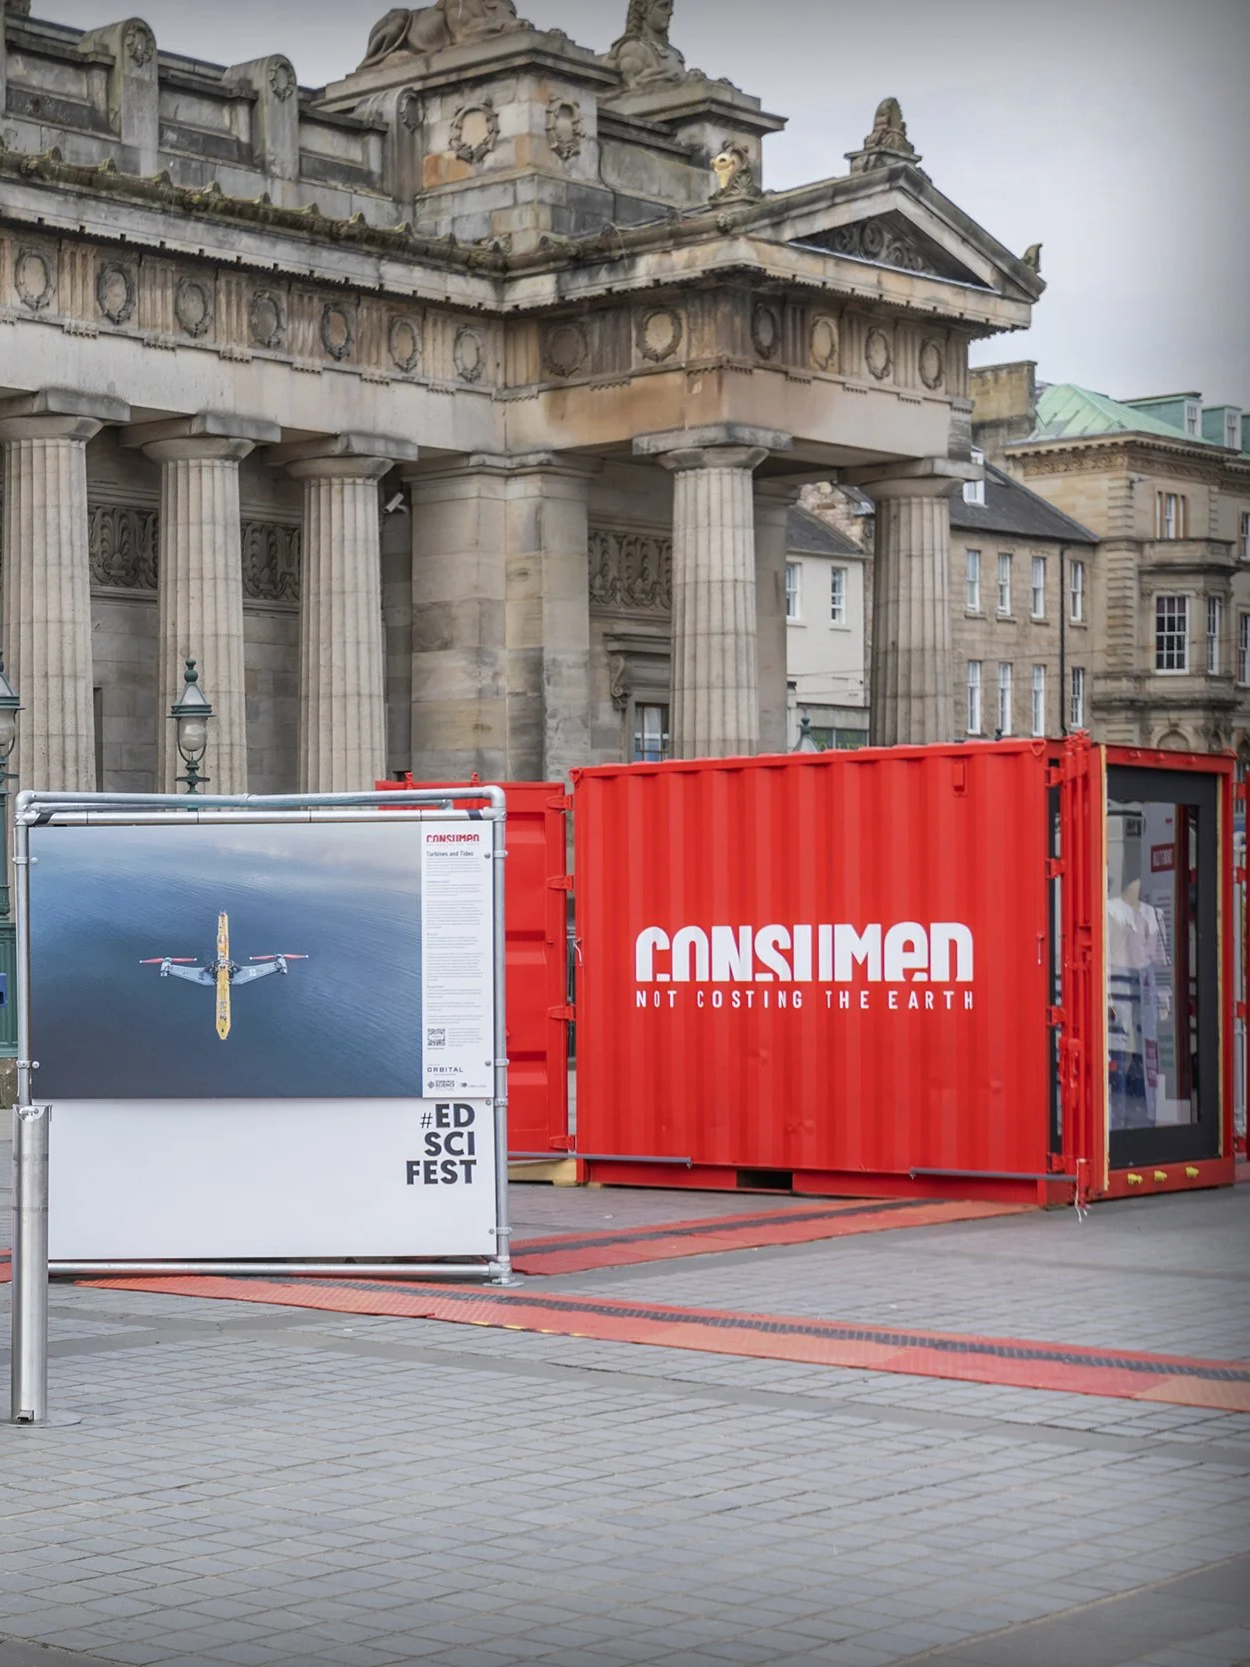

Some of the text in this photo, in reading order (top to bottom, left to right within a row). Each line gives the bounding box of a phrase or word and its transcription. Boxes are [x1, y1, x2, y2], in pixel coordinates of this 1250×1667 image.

[635, 989, 972, 1009] NOT COSTING THE EARTH
[426, 1066, 463, 1075] ORBITAL
[421, 1103, 475, 1128] #ED
[424, 1130, 475, 1157] SCI
[405, 1159, 477, 1185] FEST
